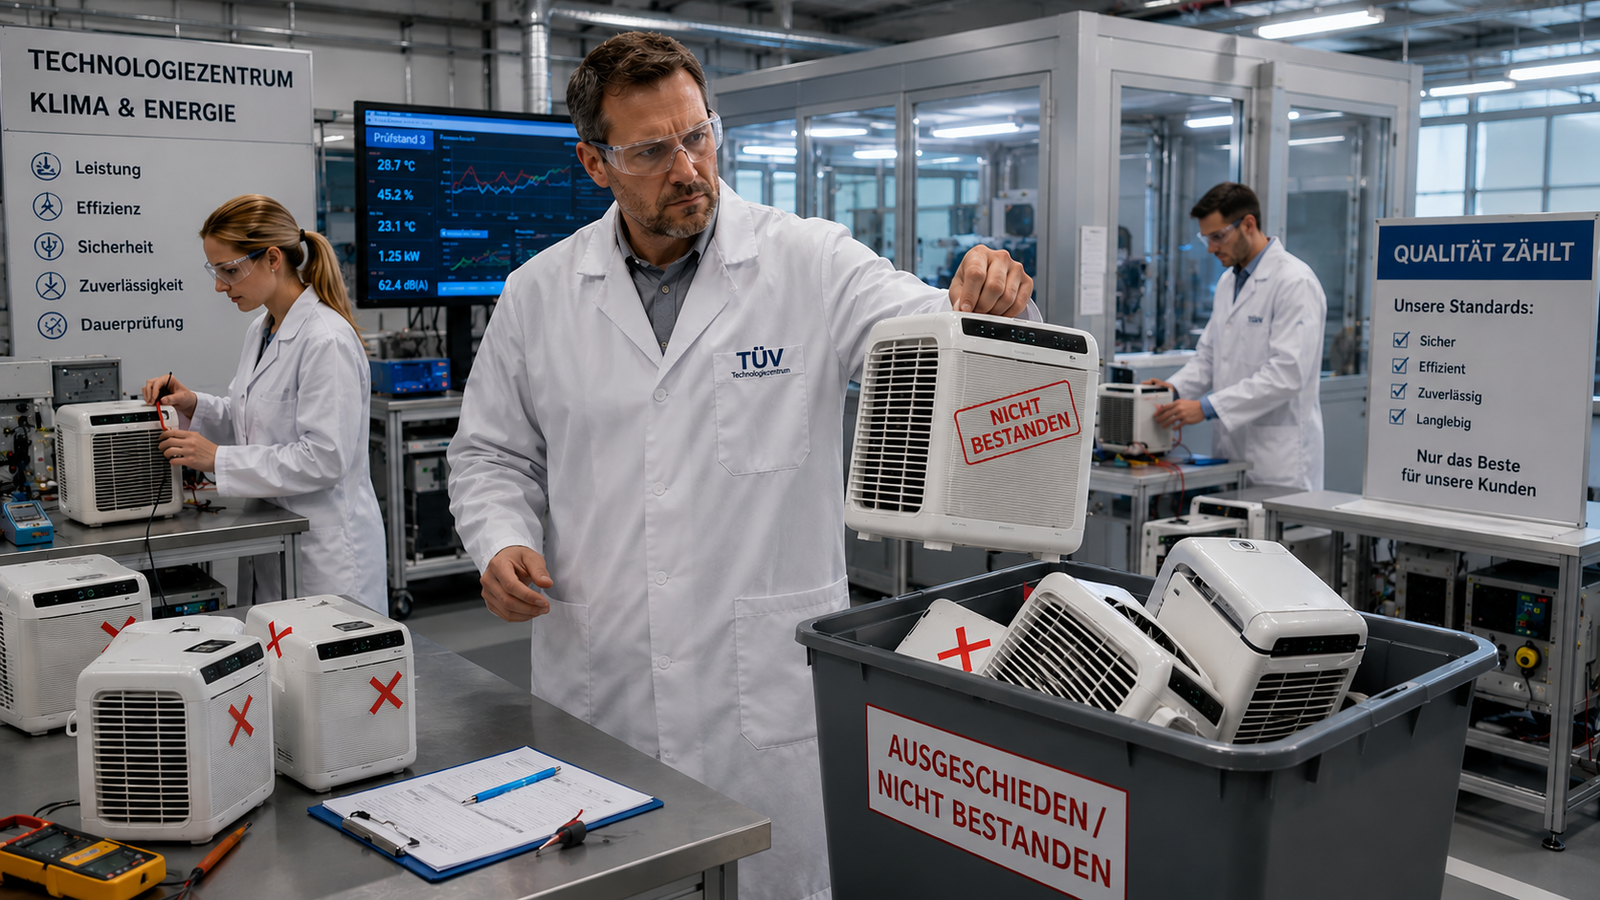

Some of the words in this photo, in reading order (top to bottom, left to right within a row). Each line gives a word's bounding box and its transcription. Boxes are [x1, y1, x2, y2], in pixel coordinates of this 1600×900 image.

[28, 48, 294, 88] TECHNOLOGIEZENTRUM
[30, 92, 110, 117] KLIMA
[118, 98, 136, 118] &
[144, 98, 236, 123] ENERGIE
[374, 132, 418, 145] Prüfstand
[419, 135, 426, 145] 3
[75, 160, 142, 179] Leistung
[377, 158, 402, 171] 28.7
[377, 188, 402, 201] 45.2
[404, 189, 414, 201] %
[76, 200, 142, 216] Effizienz
[377, 220, 401, 233] 23.1
[77, 239, 154, 255] Sicherheit
[1394, 239, 1496, 265] QUALITÄT
[1502, 238, 1575, 262] ZÄHLT
[378, 250, 402, 262] 1.25
[404, 250, 420, 262] kW
[79, 278, 184, 295] Zuverlässigkeit
[378, 279, 402, 291] 62.4
[404, 279, 429, 292] dB(A)
[1394, 298, 1445, 313] Unsere
[1449, 298, 1534, 315] Standards:
[81, 316, 184, 333] Dauerprüfung
[1420, 334, 1456, 348] Sicher
[736, 346, 784, 370] TÜV
[1419, 360, 1466, 375] Effizient
[1418, 387, 1483, 405] Zuverlässig
[989, 397, 1041, 426] NICHT
[1416, 413, 1472, 431] Langlebig
[970, 411, 1071, 455] BESTANDEN
[1416, 449, 1443, 465] Nur
[1446, 452, 1473, 468] das
[1478, 455, 1521, 473] Beste
[1401, 468, 1421, 483] für
[1425, 473, 1474, 490] unsere
[1478, 477, 1537, 497] Kunden
[878, 769, 944, 819] NICHT
[952, 798, 1111, 889] BESTANDEN
